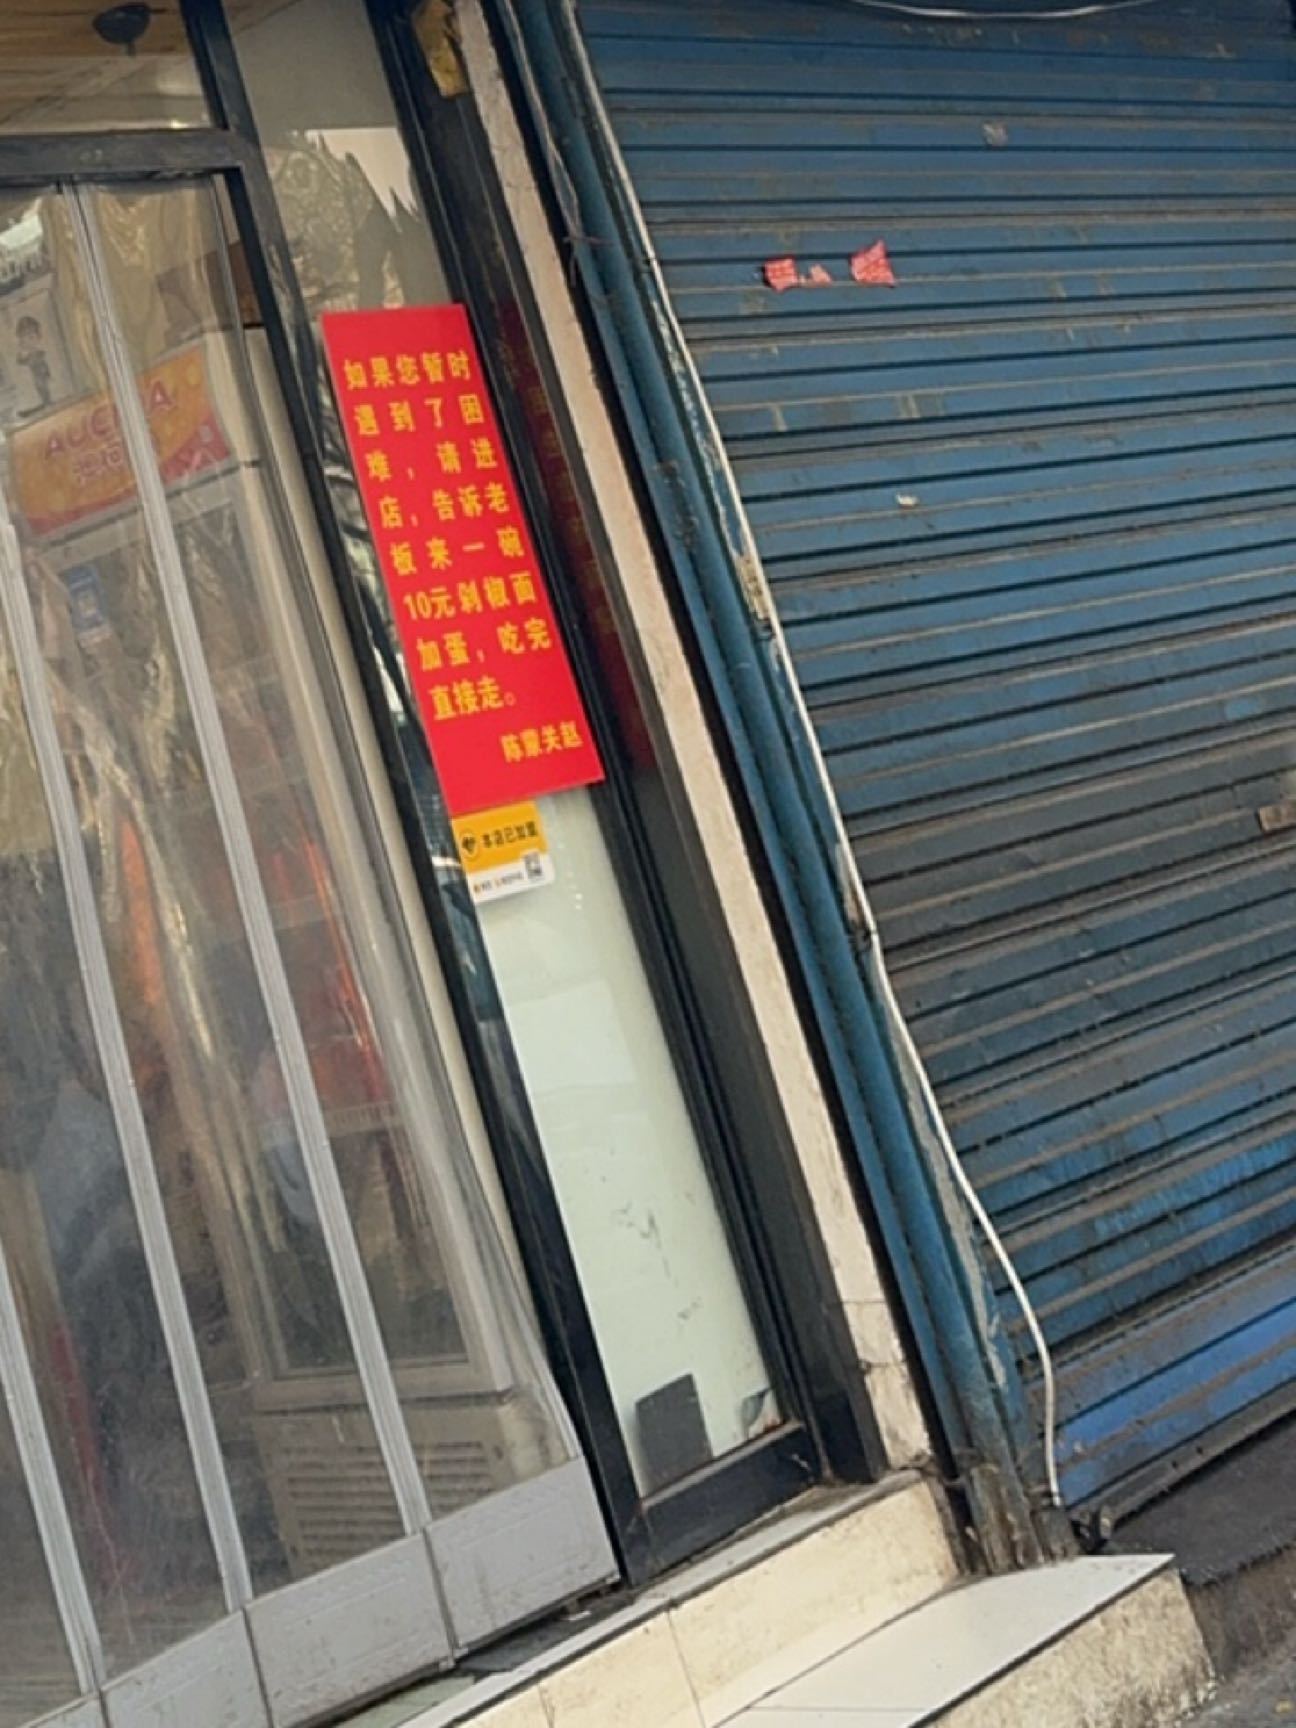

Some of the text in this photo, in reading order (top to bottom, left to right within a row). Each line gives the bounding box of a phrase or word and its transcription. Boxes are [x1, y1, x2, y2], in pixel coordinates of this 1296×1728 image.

[344, 349, 471, 391] 如果您暂时
[354, 393, 485, 436] 遇到了困
[390, 524, 525, 577] 板来一碗
[404, 570, 537, 620] 10元剁椒面
